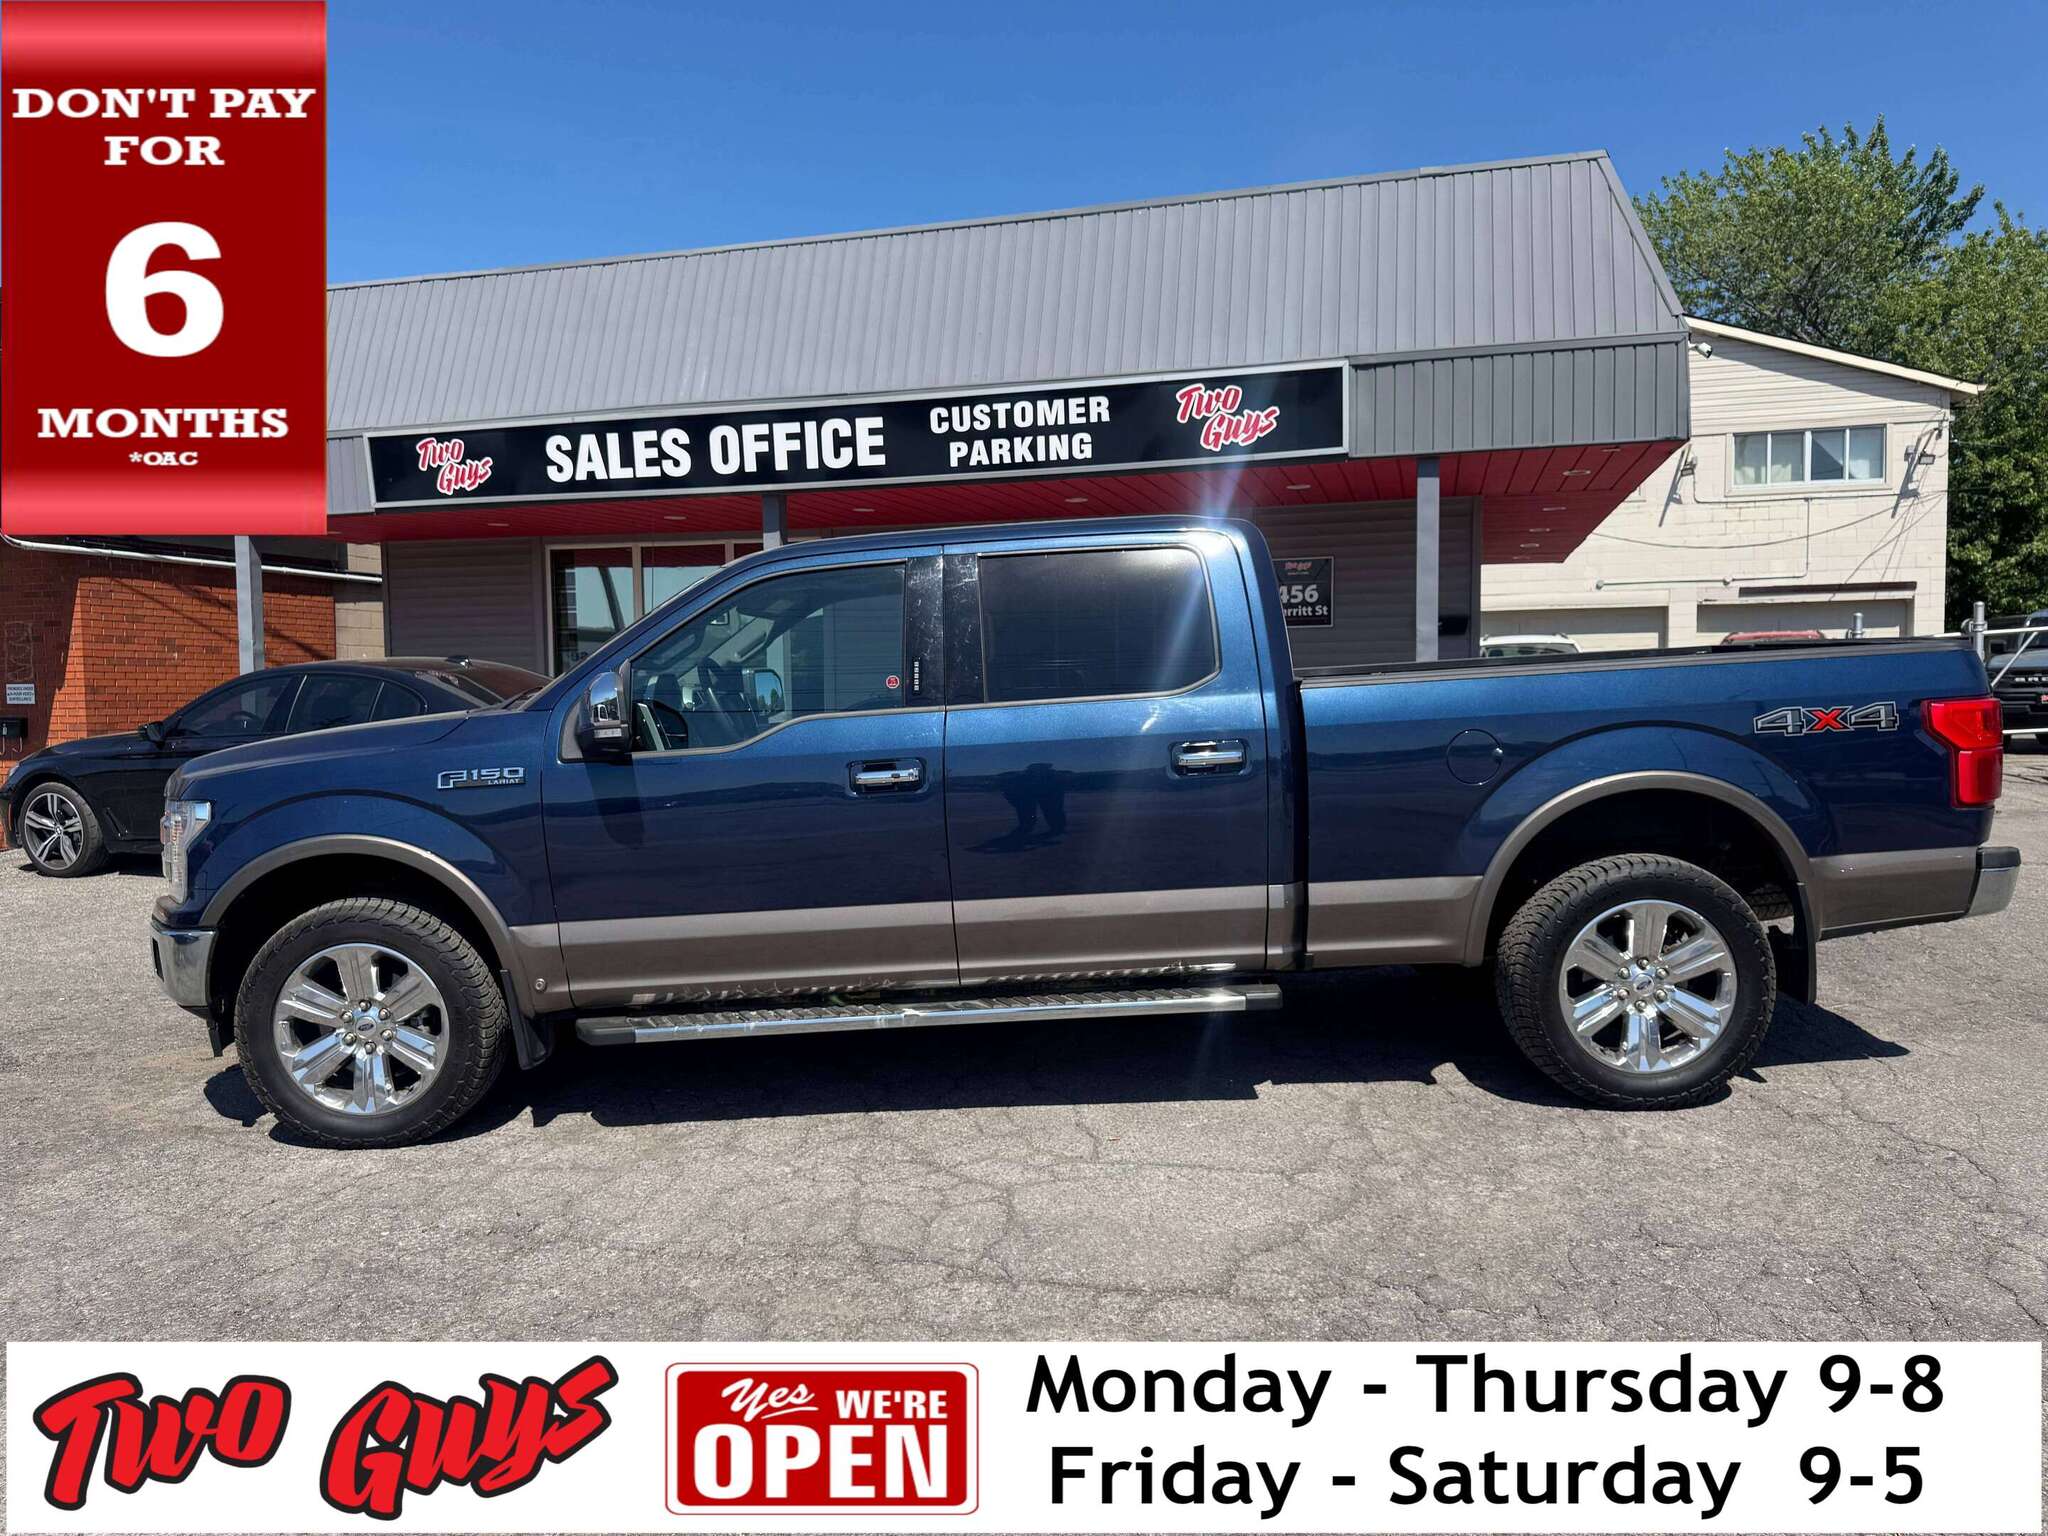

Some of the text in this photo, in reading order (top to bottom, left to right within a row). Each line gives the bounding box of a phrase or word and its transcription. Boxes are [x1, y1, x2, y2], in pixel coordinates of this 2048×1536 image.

[929, 395, 1110, 434] CUSTOMER
[1176, 383, 1242, 424] Two
[1200, 406, 1280, 452] Guys
[416, 437, 464, 471] Two
[545, 416, 886, 483] SALES OFFICE
[949, 432, 1092, 468] PARKING
[437, 456, 493, 495] Guys
[1279, 584, 1319, 604] 456
[1315, 604, 1328, 616] St
